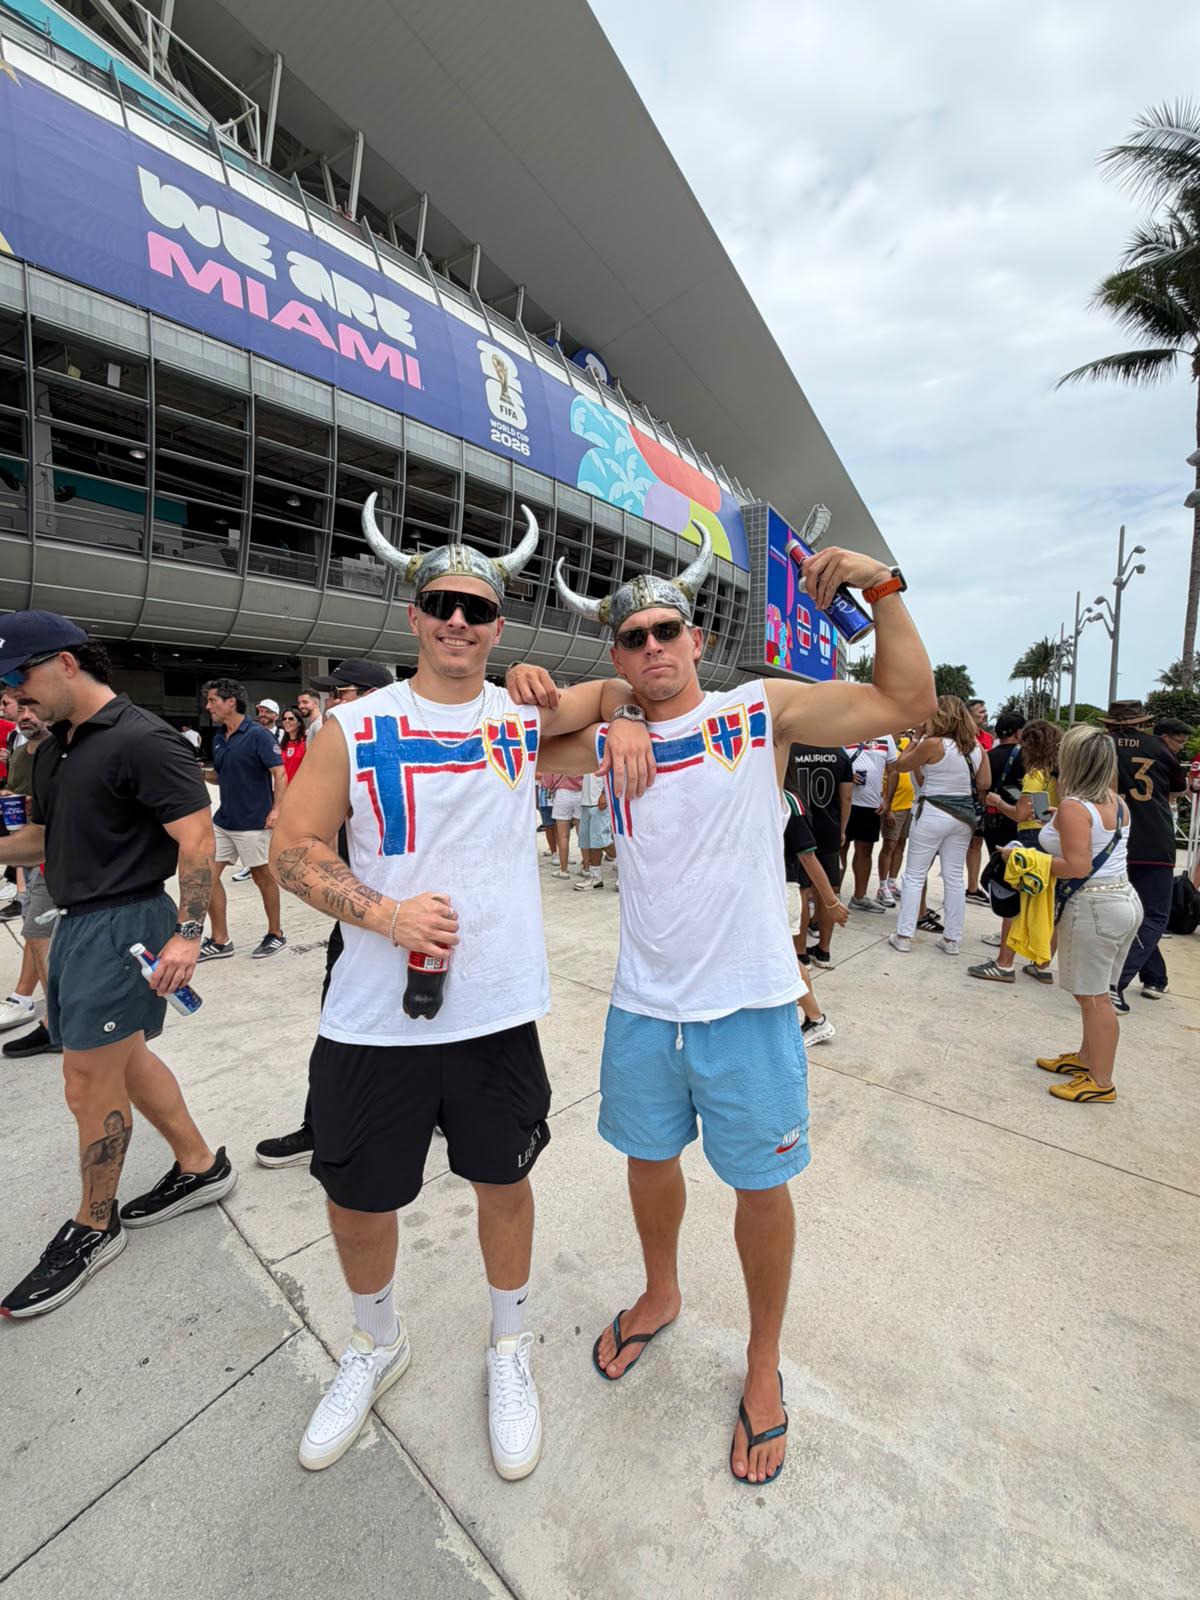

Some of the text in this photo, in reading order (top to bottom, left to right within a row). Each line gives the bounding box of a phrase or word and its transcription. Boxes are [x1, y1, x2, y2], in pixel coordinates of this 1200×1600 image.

[137, 165, 277, 281] WE
[147, 231, 423, 390] MIAMI
[499, 404, 518, 421] FIFA
[490, 418, 530, 443] WORLD CUP
[490, 428, 531, 456] 2026
[795, 754, 838, 763] MAURICIO
[796, 767, 836, 809] 10
[1129, 756, 1155, 802] 3
